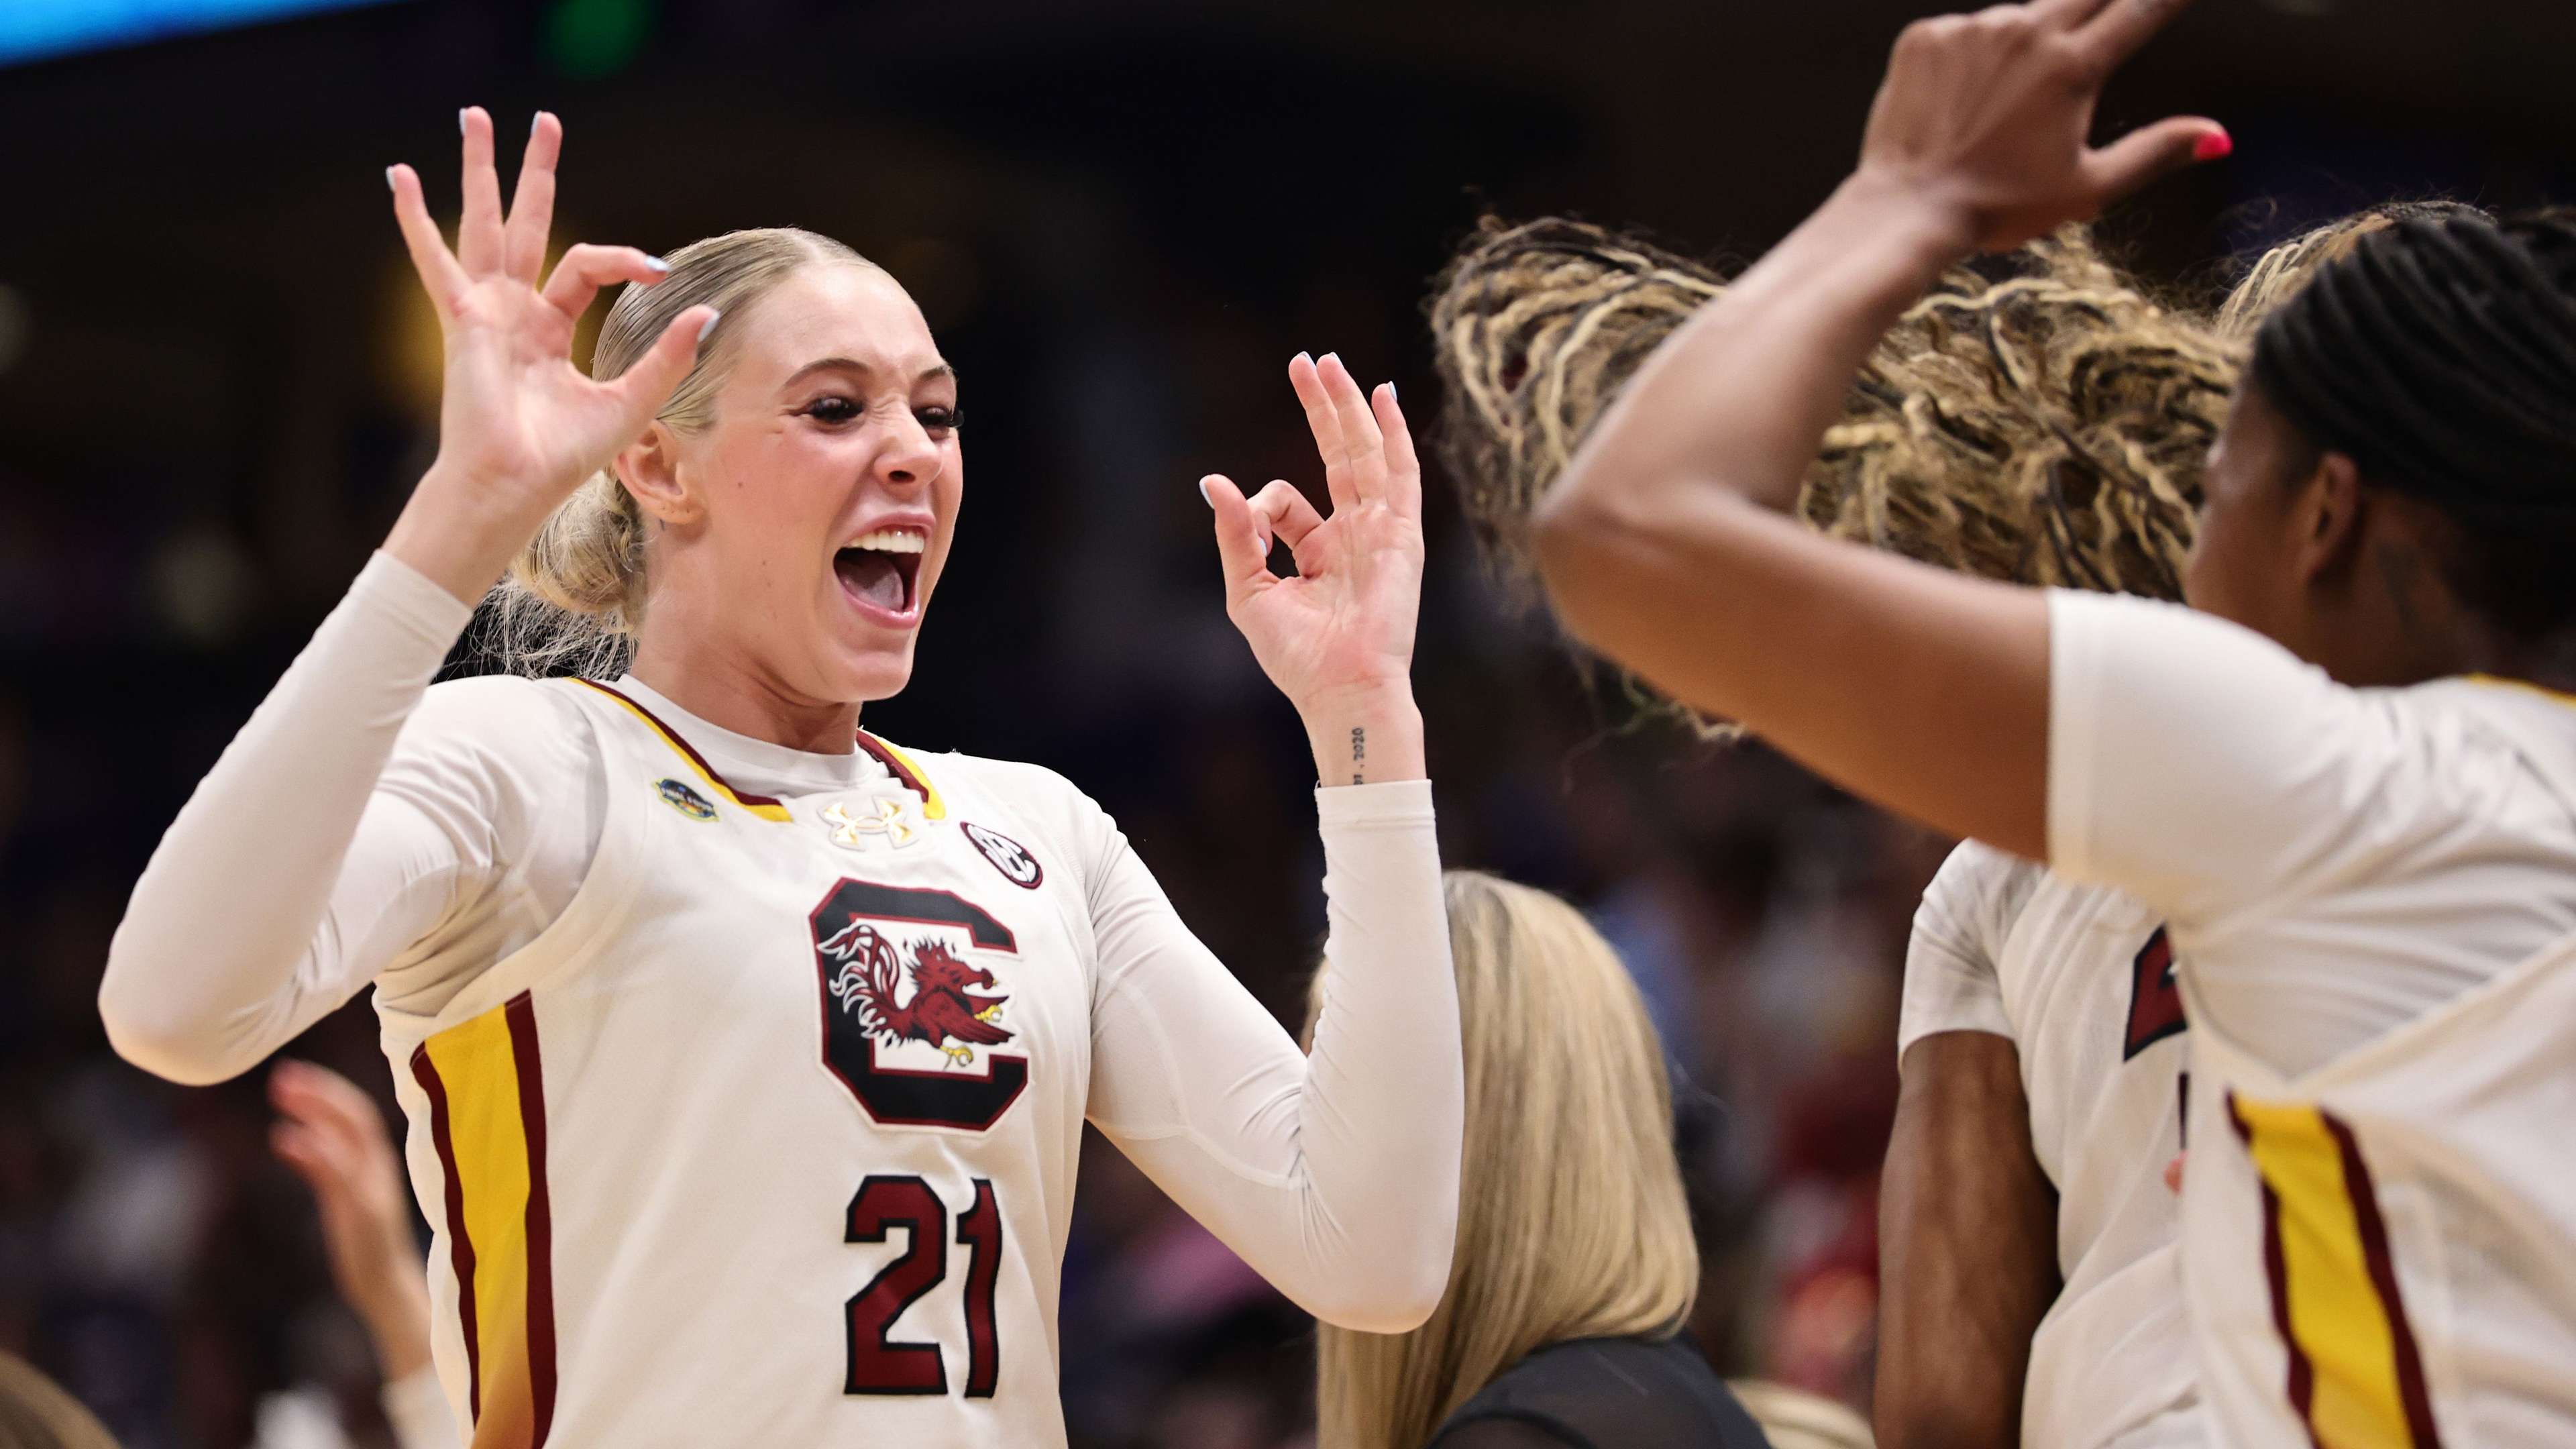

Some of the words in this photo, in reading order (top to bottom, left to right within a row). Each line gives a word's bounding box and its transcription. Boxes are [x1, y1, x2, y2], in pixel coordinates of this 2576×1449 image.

[967, 824, 1036, 883] SEC
[809, 877, 1028, 1132] C
[844, 1175, 1002, 1398] 21
